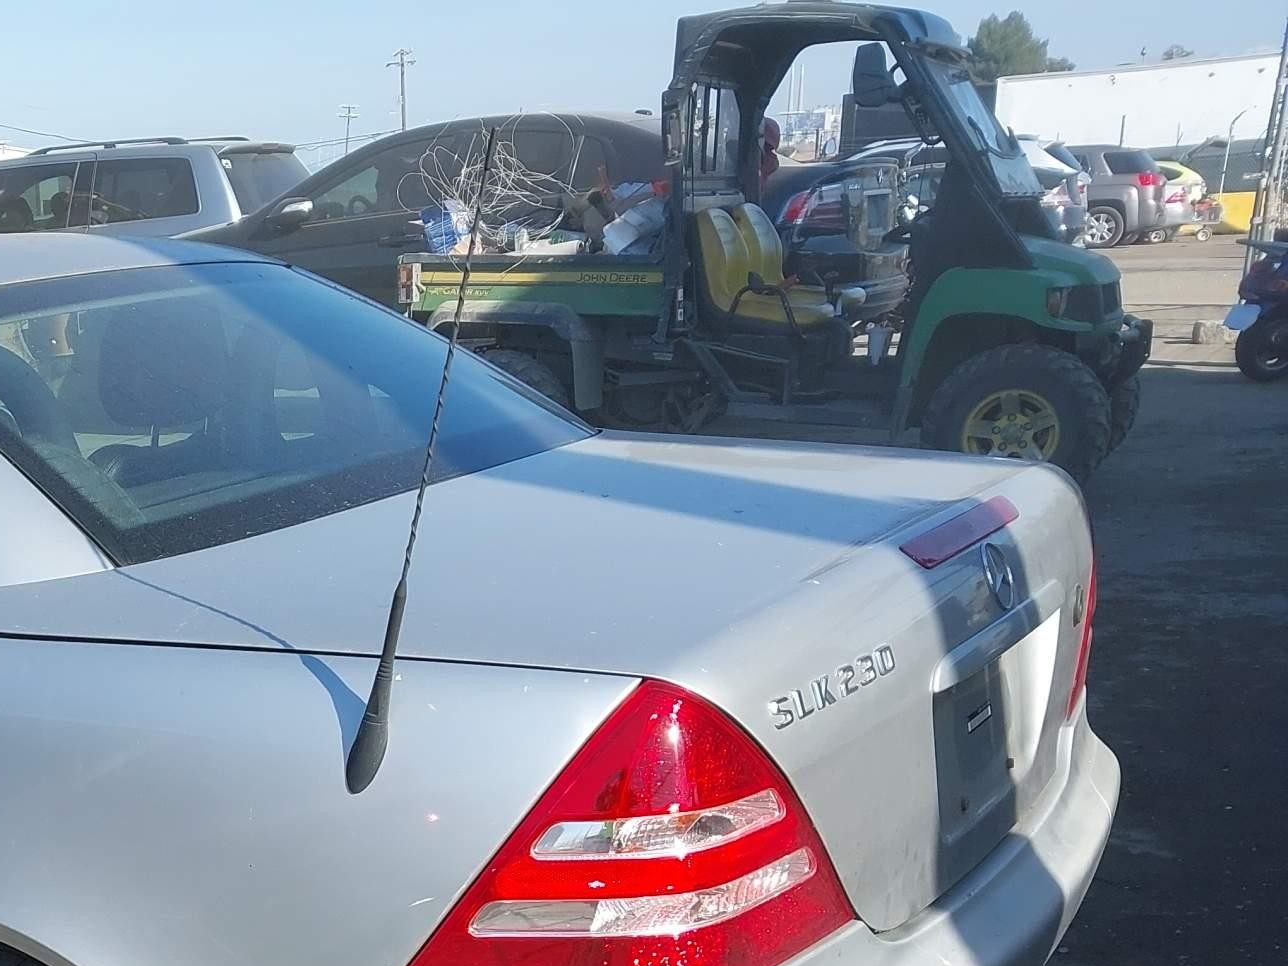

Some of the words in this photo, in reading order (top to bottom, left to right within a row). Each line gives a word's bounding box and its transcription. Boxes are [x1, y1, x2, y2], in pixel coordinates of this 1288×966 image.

[576, 272, 607, 282] JOHN
[610, 272, 648, 283] DEERE
[767, 674, 837, 730] SLK
[835, 643, 896, 698] 230
